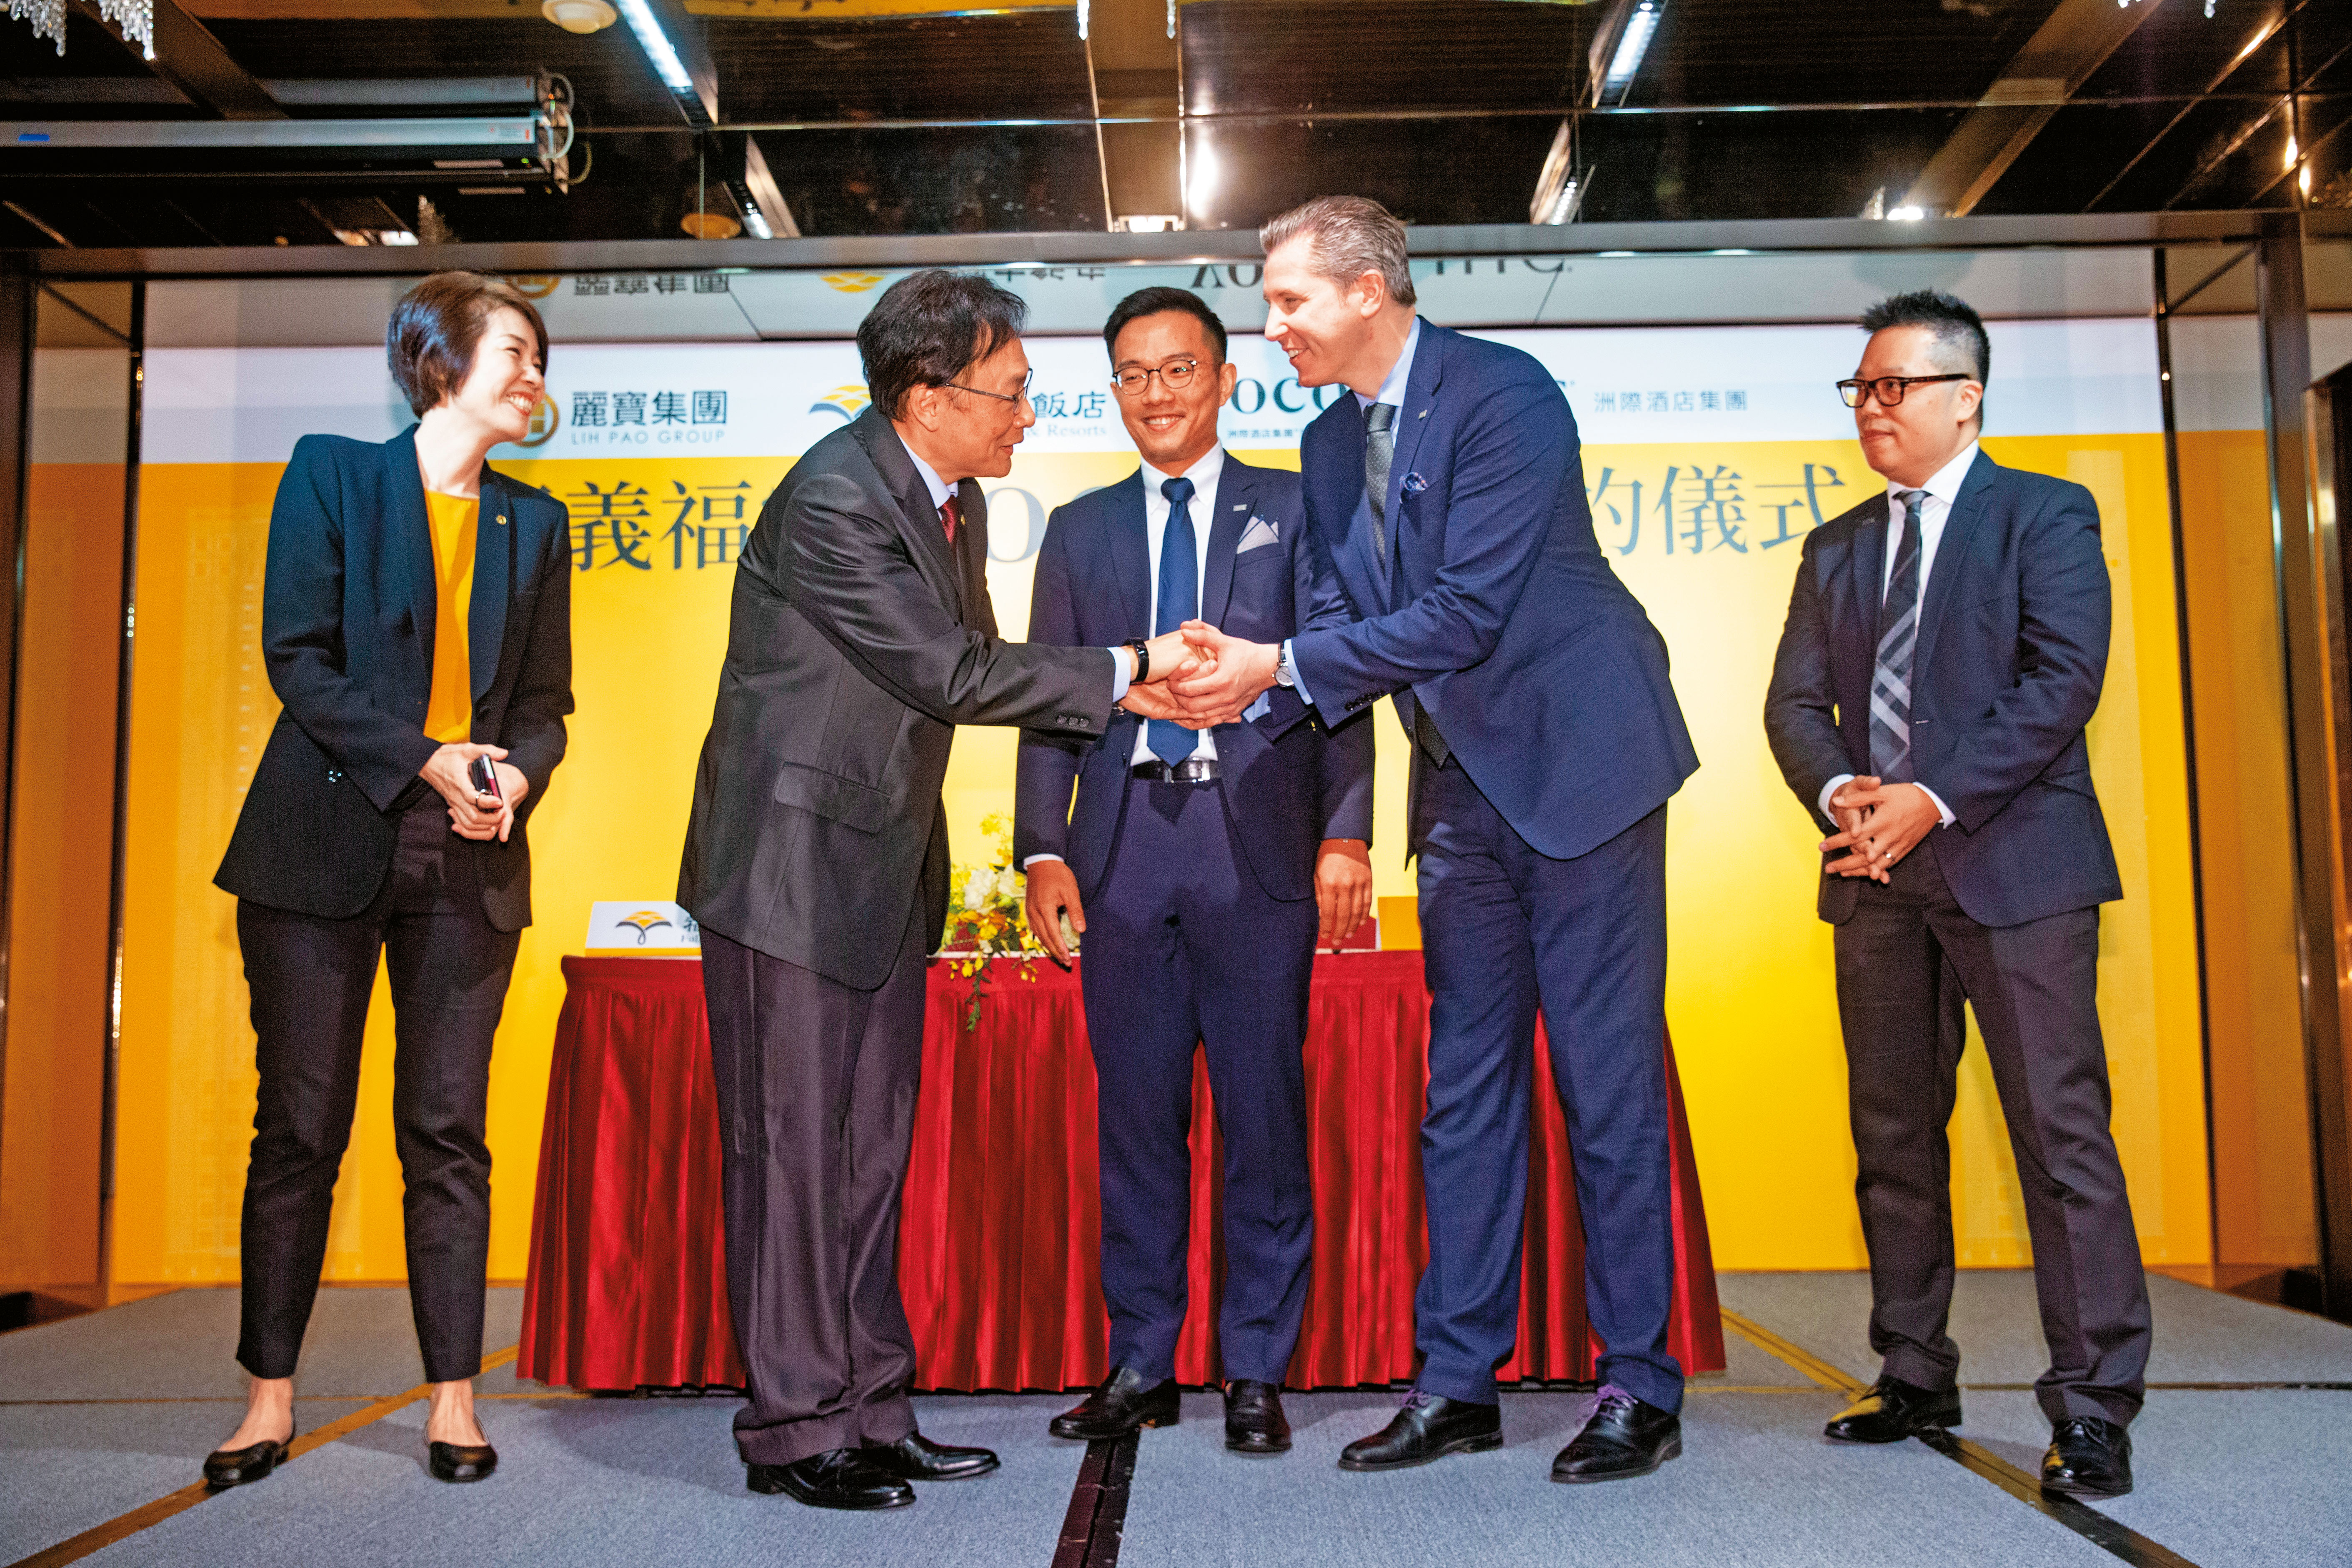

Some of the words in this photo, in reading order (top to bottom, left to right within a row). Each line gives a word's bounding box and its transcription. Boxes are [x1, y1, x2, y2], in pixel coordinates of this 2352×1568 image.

[571, 389, 727, 427] 麗寶集團
[1031, 391, 1106, 418] 飯店
[1594, 390, 1748, 413] 洲際酒店集團
[570, 431, 600, 445] LIH
[608, 430, 649, 444] PAO
[656, 429, 726, 444] GROUP
[1047, 424, 1106, 435] Resorts
[539, 480, 775, 572] 義福
